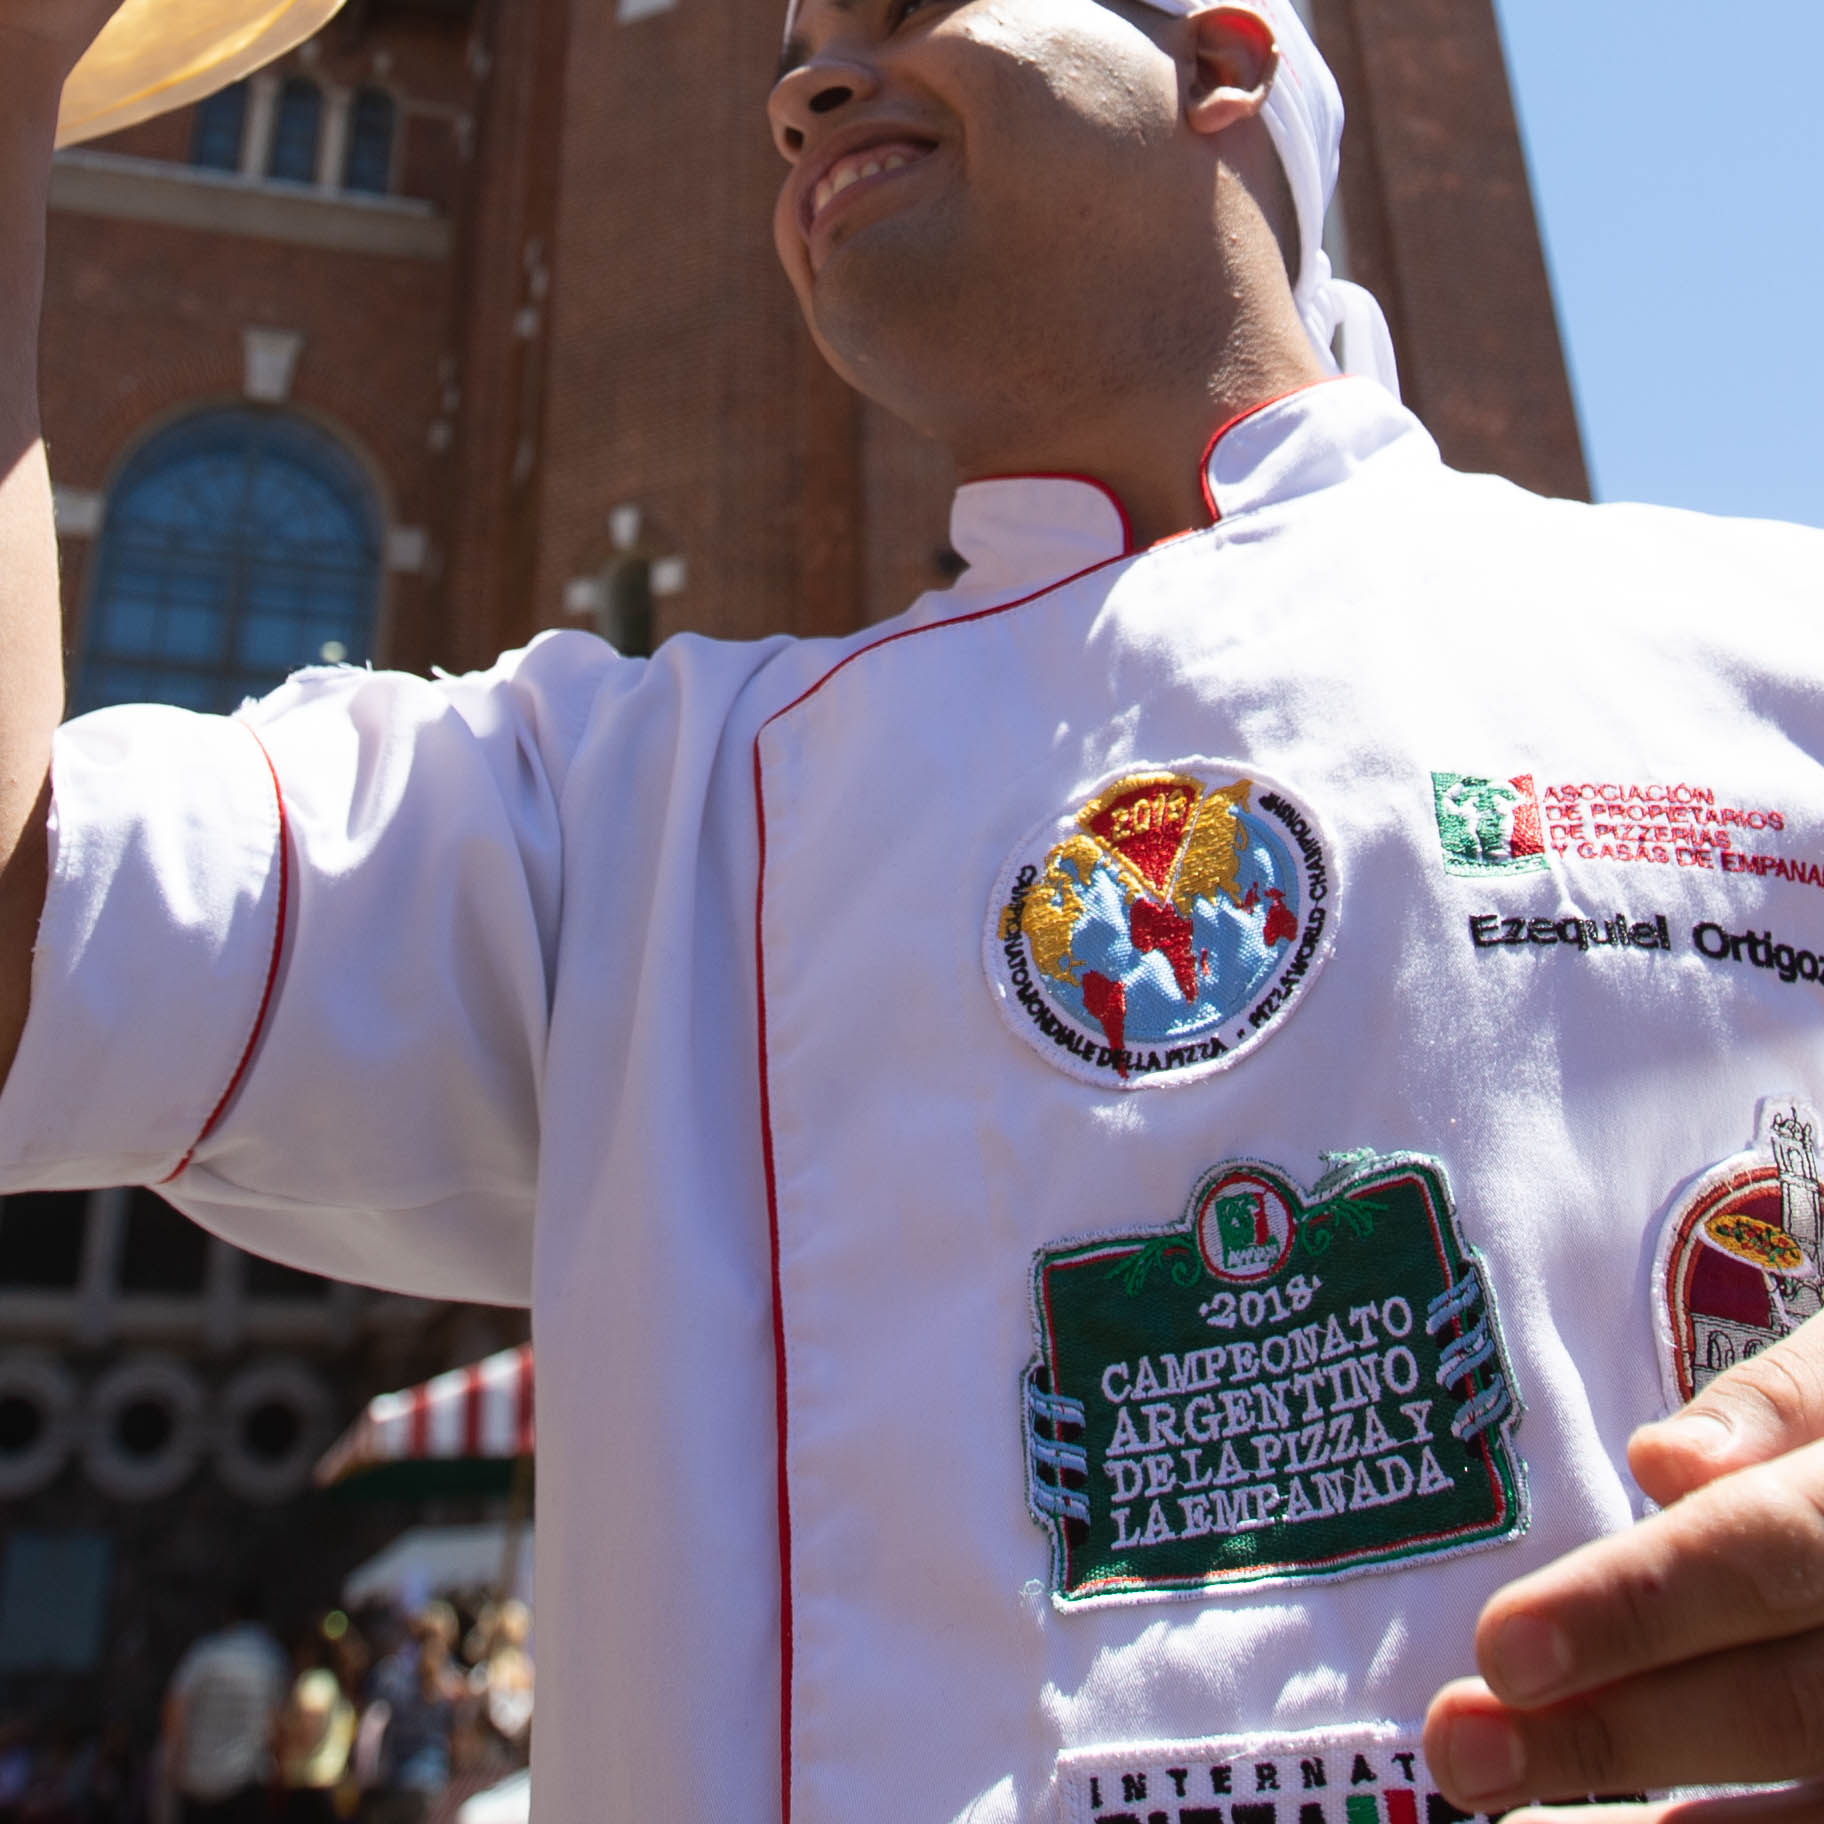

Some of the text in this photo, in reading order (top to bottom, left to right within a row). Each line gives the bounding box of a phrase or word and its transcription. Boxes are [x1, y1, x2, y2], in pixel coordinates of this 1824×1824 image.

[1543, 782, 1715, 806] ASOCIACIÓN
[1545, 803, 1785, 832] DE PROPIETARIOS
[1550, 823, 1586, 841] DE
[1551, 843, 1569, 859] Y
[1577, 842, 1670, 864] CASAS
[1676, 846, 1715, 870] DE
[1469, 912, 1672, 951] Ezequiel
[1248, 977, 1300, 1029] PIZZA
[1286, 907, 1326, 977] WORLD
[1095, 1044, 1164, 1073] DELLA
[1162, 1036, 1229, 1070] PIZZA
[1101, 1296, 1413, 1404] CAMPEONATO
[1105, 1345, 1419, 1457] ARGENTINO
[1102, 1399, 1434, 1504] DE LA PIZZA Y
[1110, 1445, 1456, 1551] LA EMPANADA
[1089, 1751, 1416, 1810] INTERNAT
